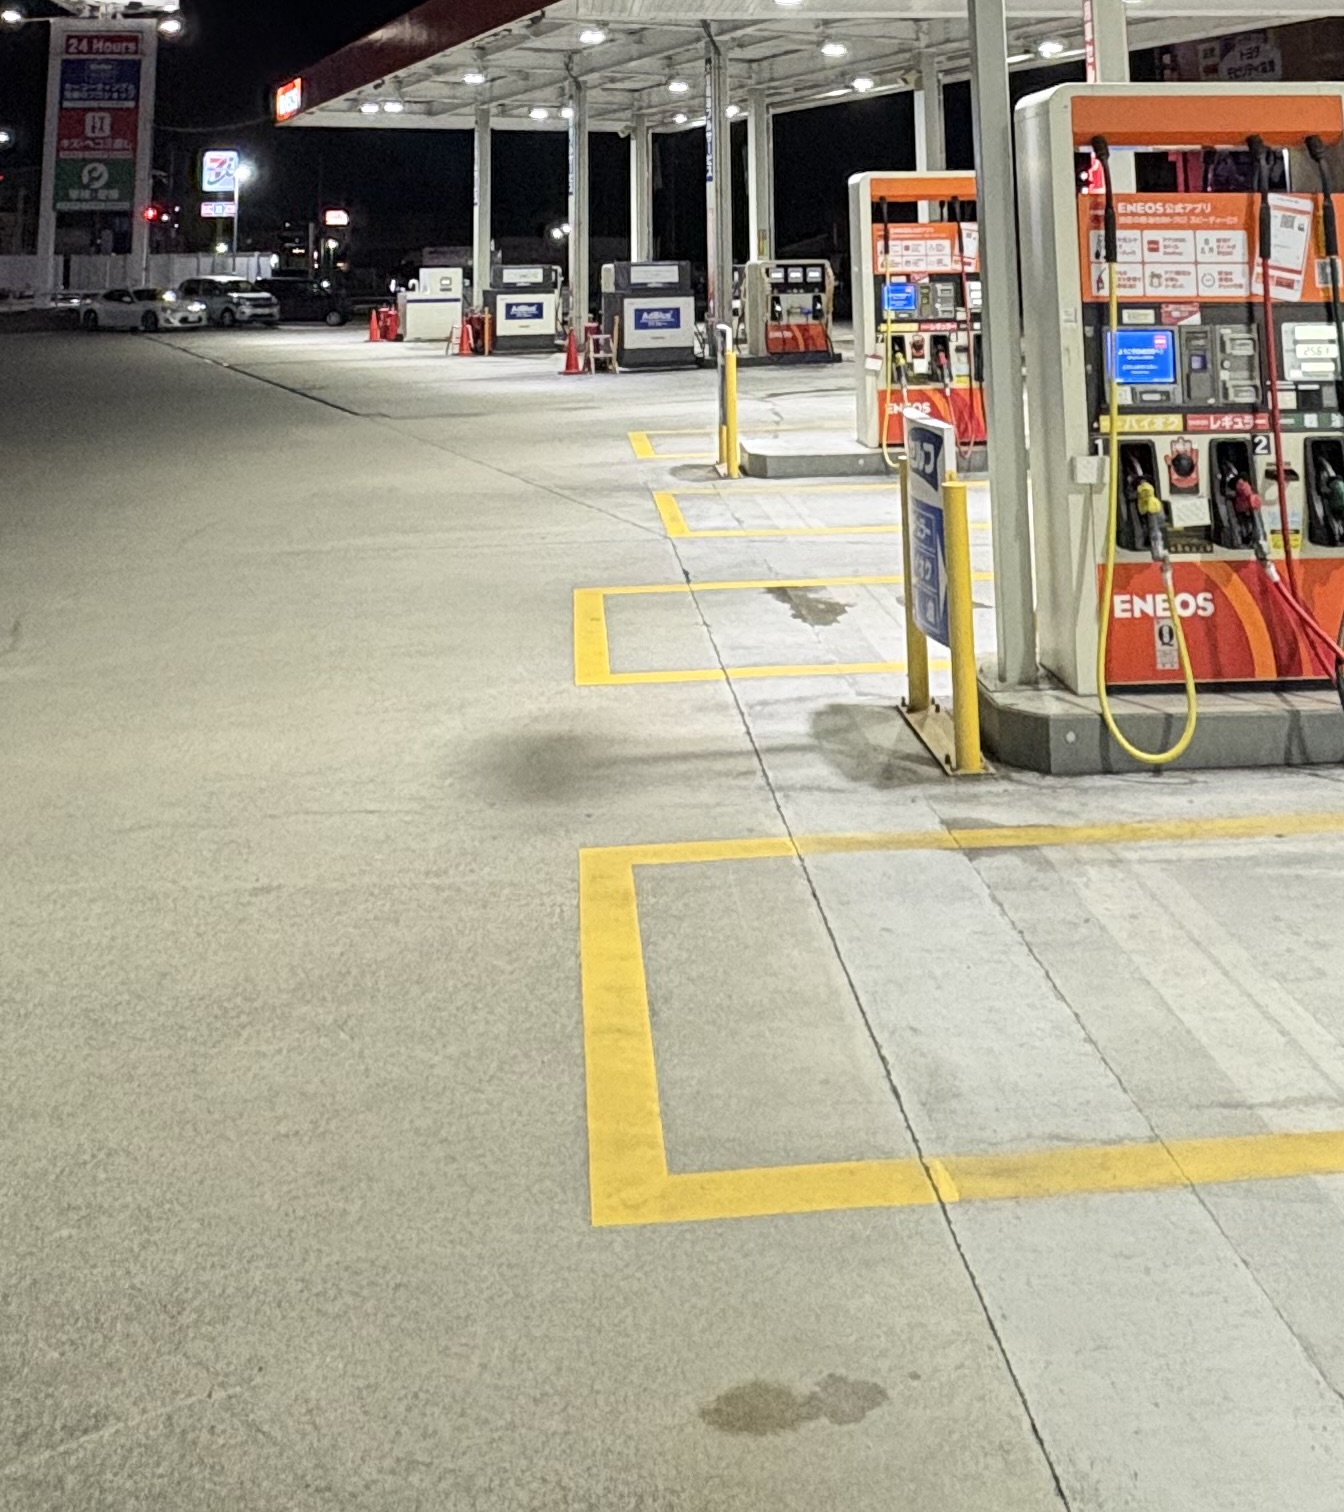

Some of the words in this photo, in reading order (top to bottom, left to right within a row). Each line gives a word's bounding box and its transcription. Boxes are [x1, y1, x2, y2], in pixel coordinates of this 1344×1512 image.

[67, 37, 89, 54] 24
[92, 37, 137, 54] Hours
[1117, 201, 1164, 214] ENEOS
[1164, 202, 1212, 214] 公式アプリ
[1209, 413, 1268, 431] レギュラー
[1094, 438, 1104, 457] 1
[1253, 435, 1269, 454] 2
[1113, 591, 1215, 619] ENEOS
